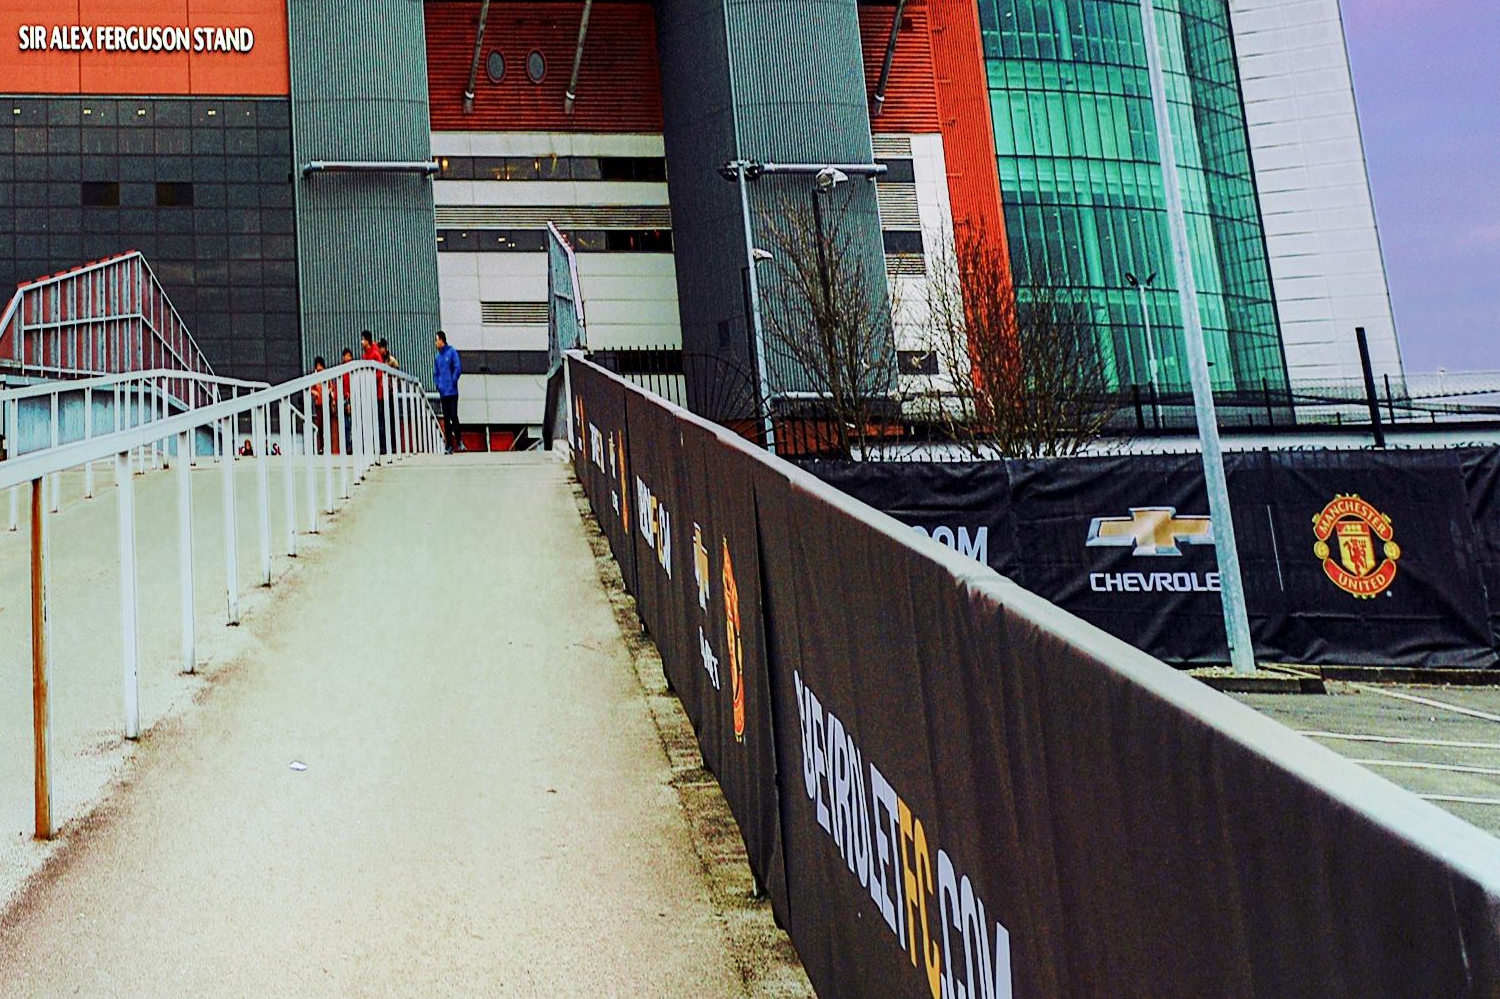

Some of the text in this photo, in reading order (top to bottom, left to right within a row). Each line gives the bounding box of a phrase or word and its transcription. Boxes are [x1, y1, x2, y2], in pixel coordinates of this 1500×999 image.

[18, 25, 254, 52] SIR ALEX FERGUSON STAND
[1320, 501, 1386, 534] MANCHESTER
[1089, 572, 1221, 592] CHEVROLE
[1338, 573, 1386, 591] UNITED
